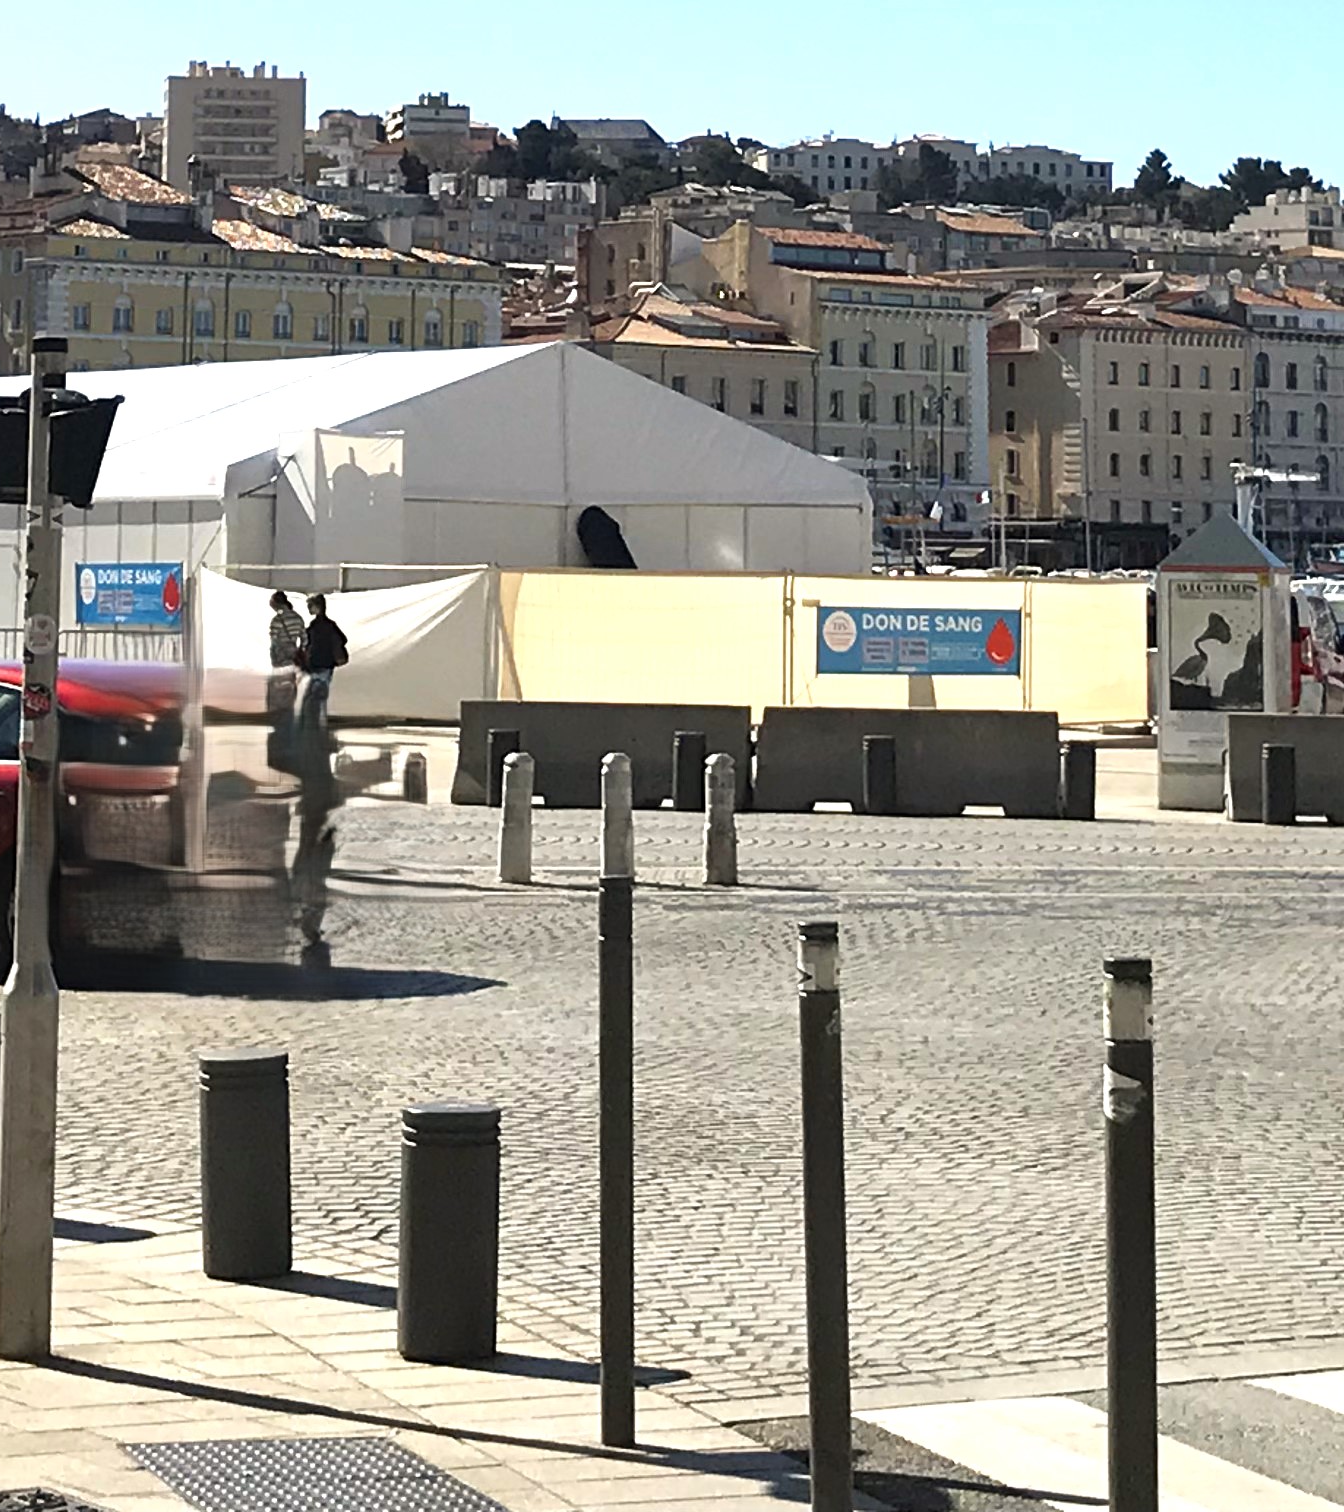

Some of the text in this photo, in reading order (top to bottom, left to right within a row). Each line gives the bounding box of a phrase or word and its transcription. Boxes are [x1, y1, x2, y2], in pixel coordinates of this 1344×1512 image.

[97, 569, 163, 585] DON DE SANG
[862, 613, 982, 633] DON DE SANG
